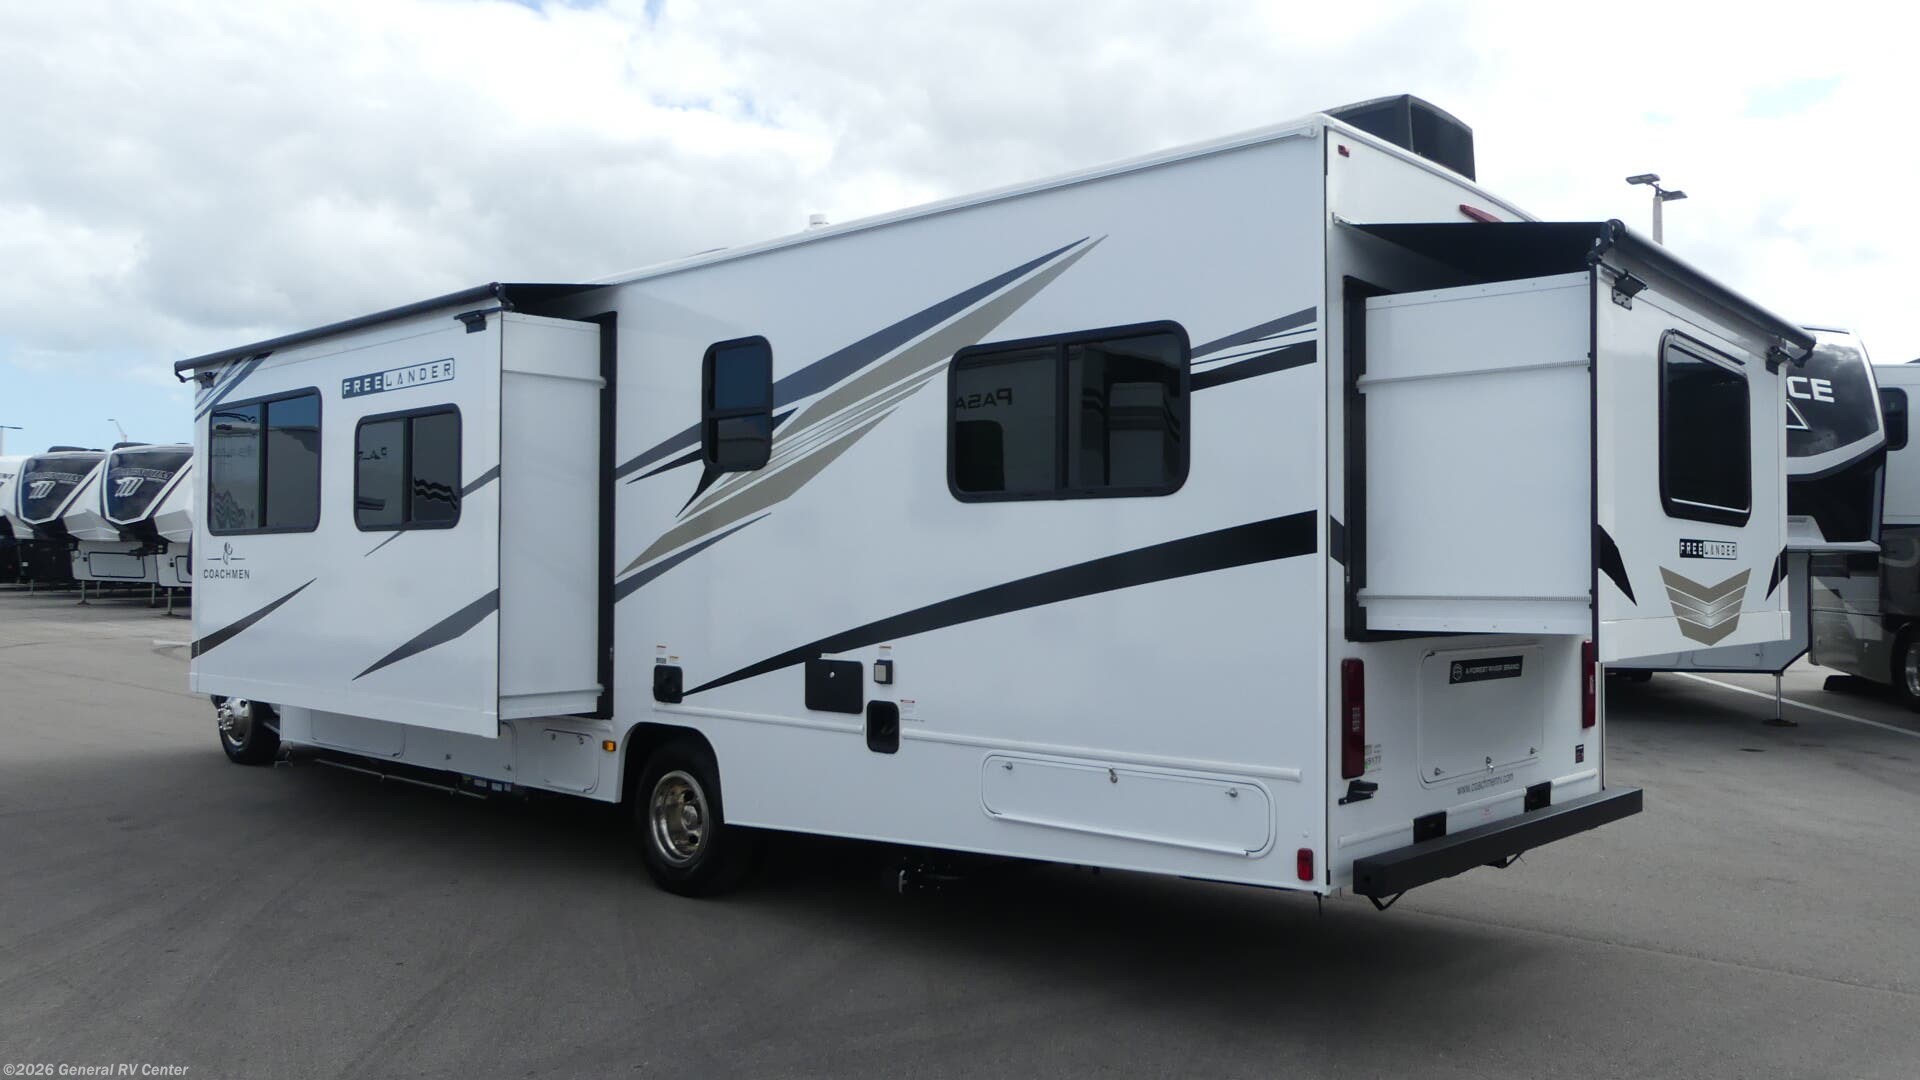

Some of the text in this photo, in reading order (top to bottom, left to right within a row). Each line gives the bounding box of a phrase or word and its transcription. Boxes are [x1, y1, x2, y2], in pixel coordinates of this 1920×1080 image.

[343, 362, 452, 396] FREELANDER
[1680, 541, 1736, 557] FREELANDER
[203, 569, 250, 579] COACHMEN
